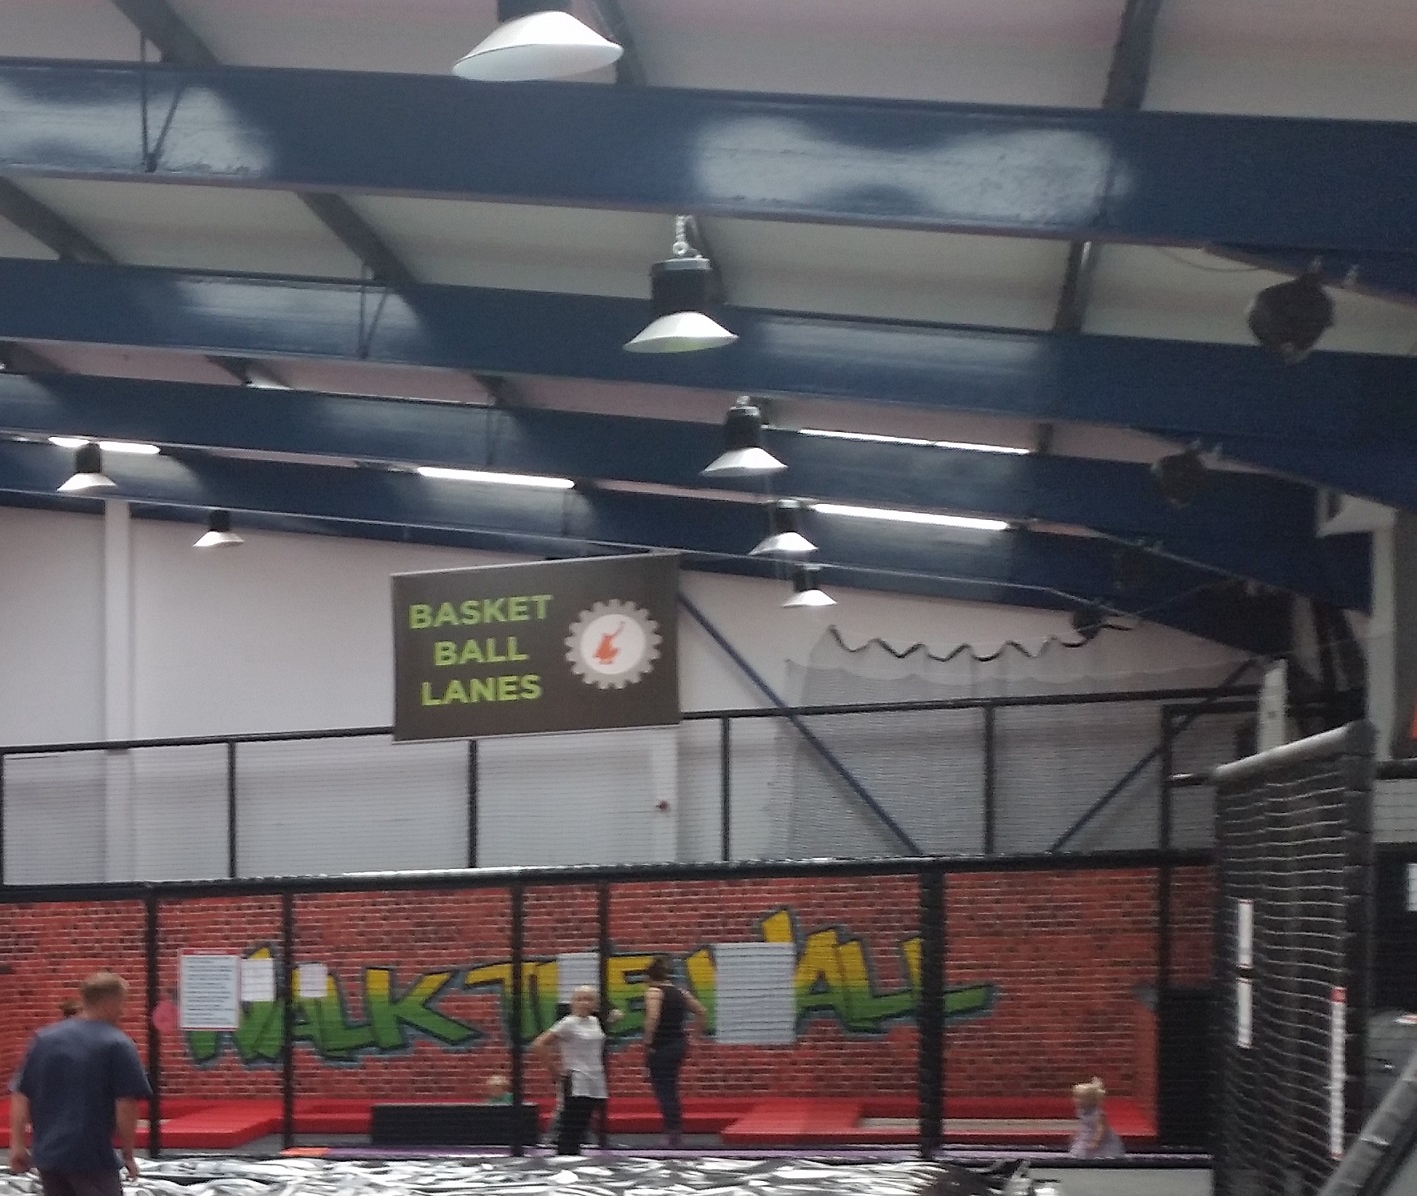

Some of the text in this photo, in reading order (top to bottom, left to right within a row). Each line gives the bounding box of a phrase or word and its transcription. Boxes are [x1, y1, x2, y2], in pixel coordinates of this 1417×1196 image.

[408, 594, 553, 629] BASKET
[434, 637, 529, 666] BALL
[421, 674, 543, 706] LANES
